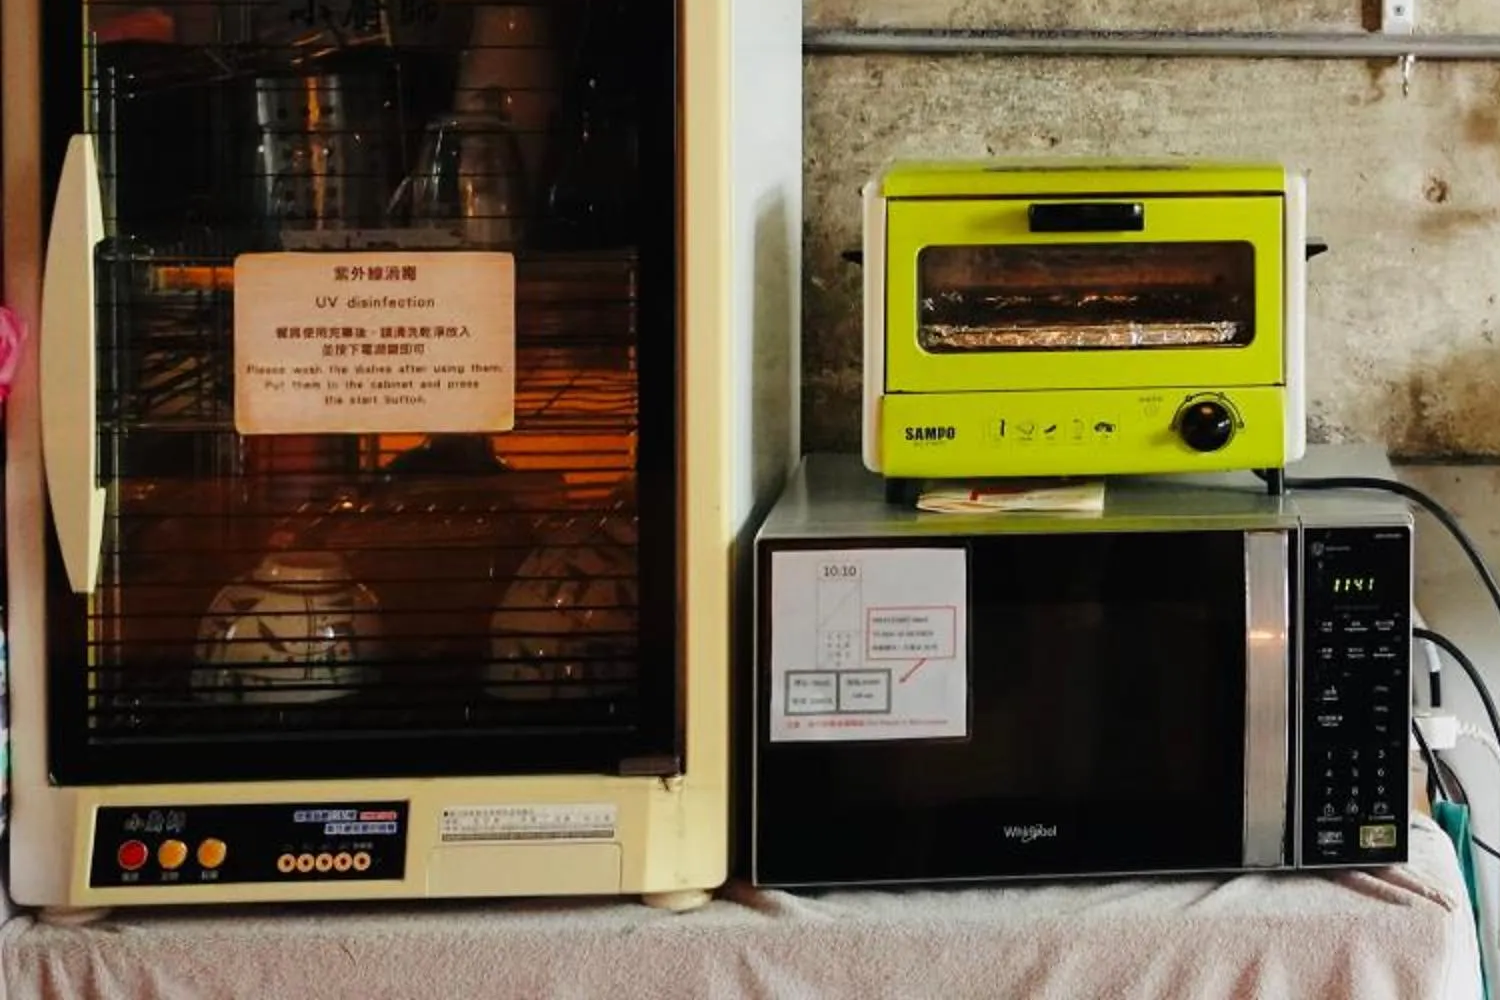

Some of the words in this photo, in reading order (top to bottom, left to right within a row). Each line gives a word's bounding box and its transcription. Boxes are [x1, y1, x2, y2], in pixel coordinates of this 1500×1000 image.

[315, 296, 338, 309] UV
[347, 295, 436, 309] disinfection
[905, 426, 956, 441] SAMPO
